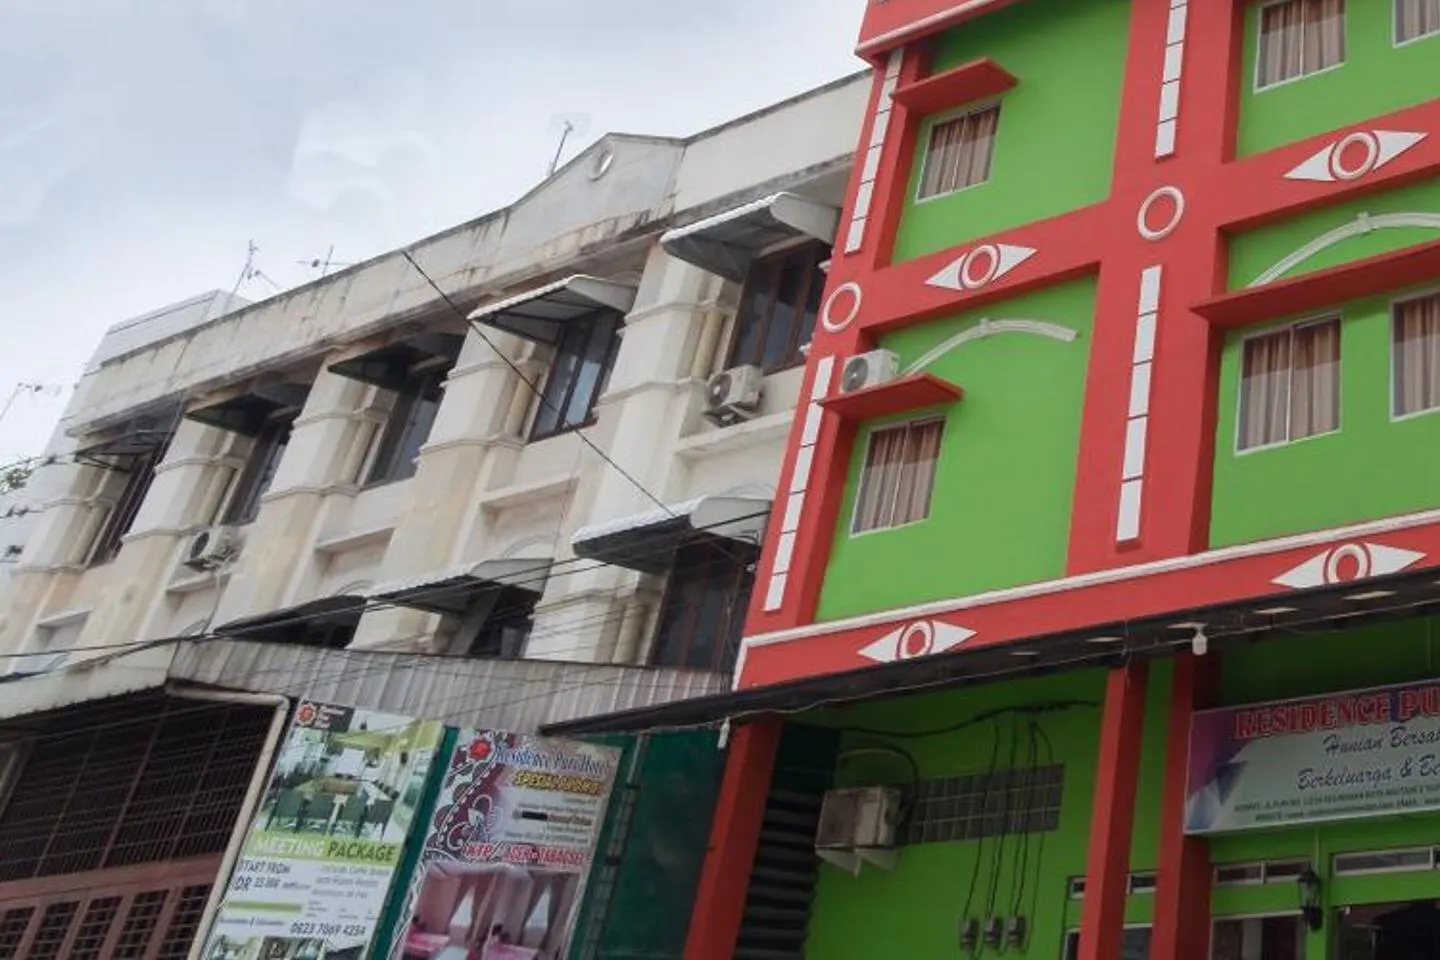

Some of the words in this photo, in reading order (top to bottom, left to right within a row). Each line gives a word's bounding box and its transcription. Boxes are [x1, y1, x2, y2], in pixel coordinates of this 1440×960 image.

[1235, 694, 1390, 739] RESIDENCE
[1323, 733, 1383, 755] Hunian
[1297, 765, 1394, 790] Berkeluarga
[1399, 756, 1413, 778] &
[326, 840, 397, 862] PACKAGE
